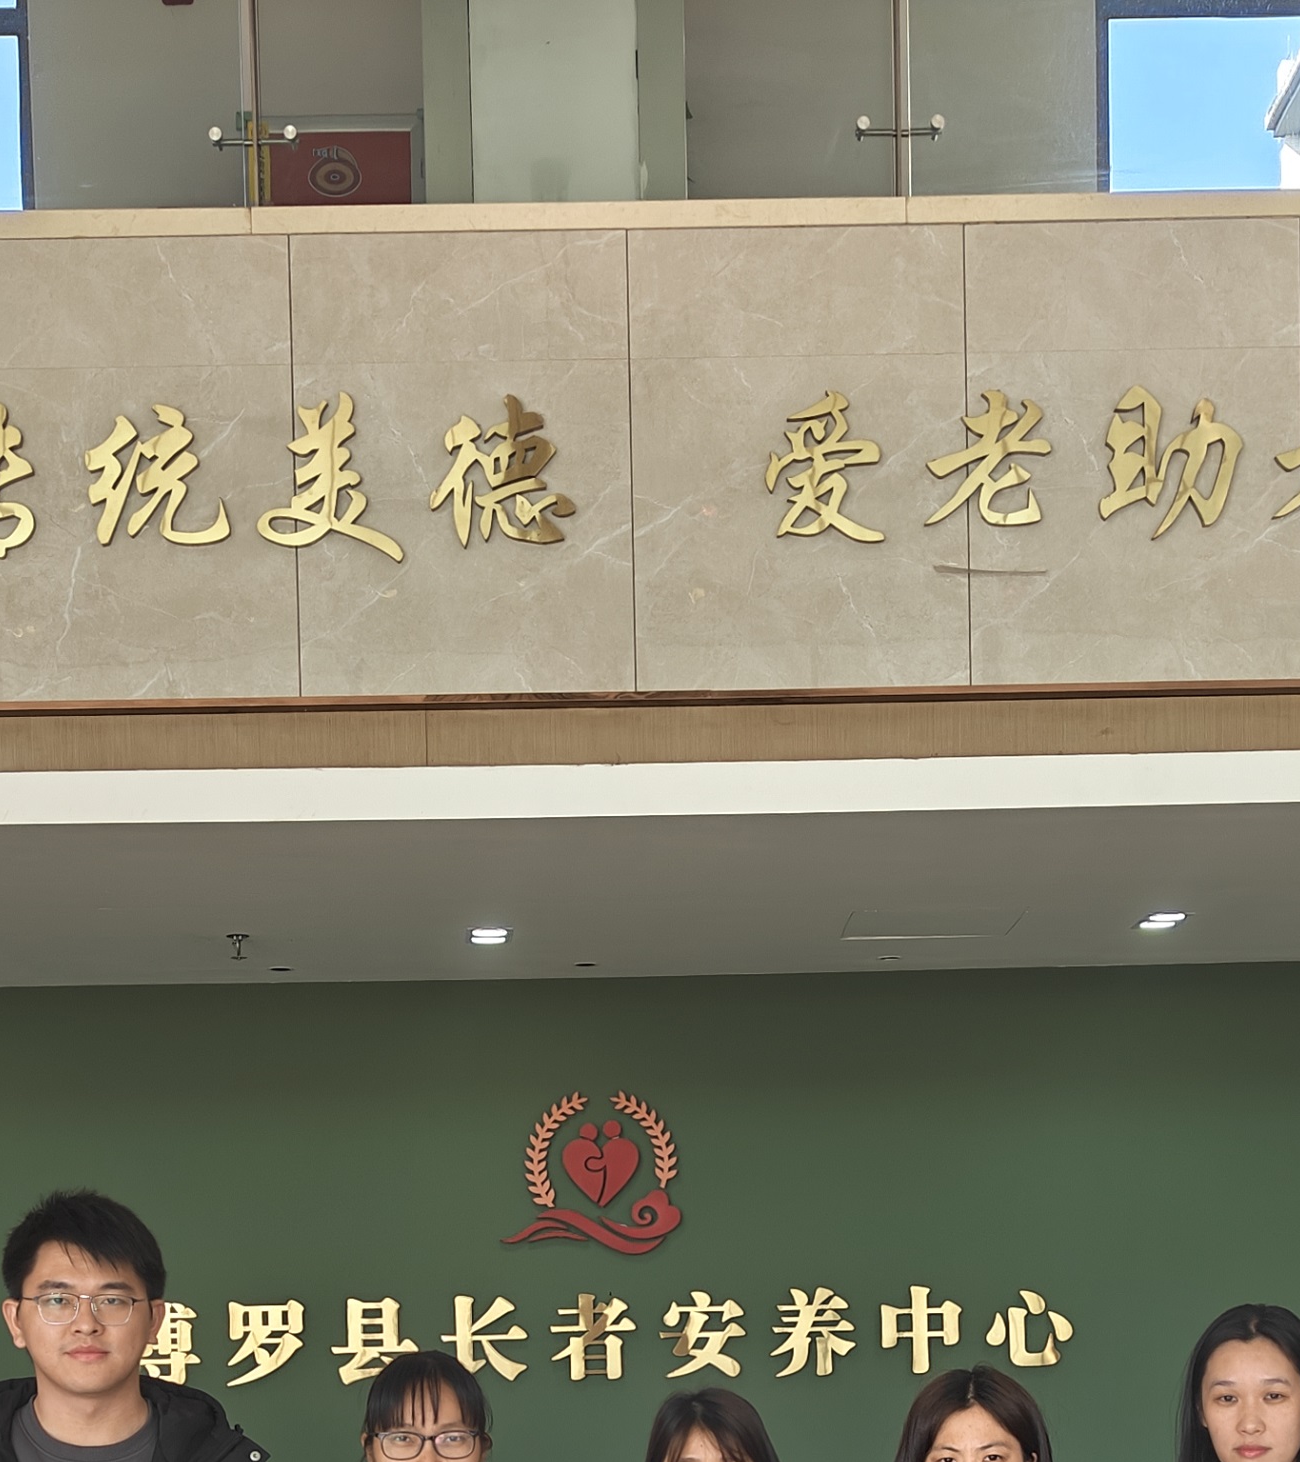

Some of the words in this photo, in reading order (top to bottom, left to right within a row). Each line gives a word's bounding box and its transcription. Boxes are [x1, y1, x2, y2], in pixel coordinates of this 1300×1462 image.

[140, 1284, 1076, 1388] 博罗县长者安养中心
